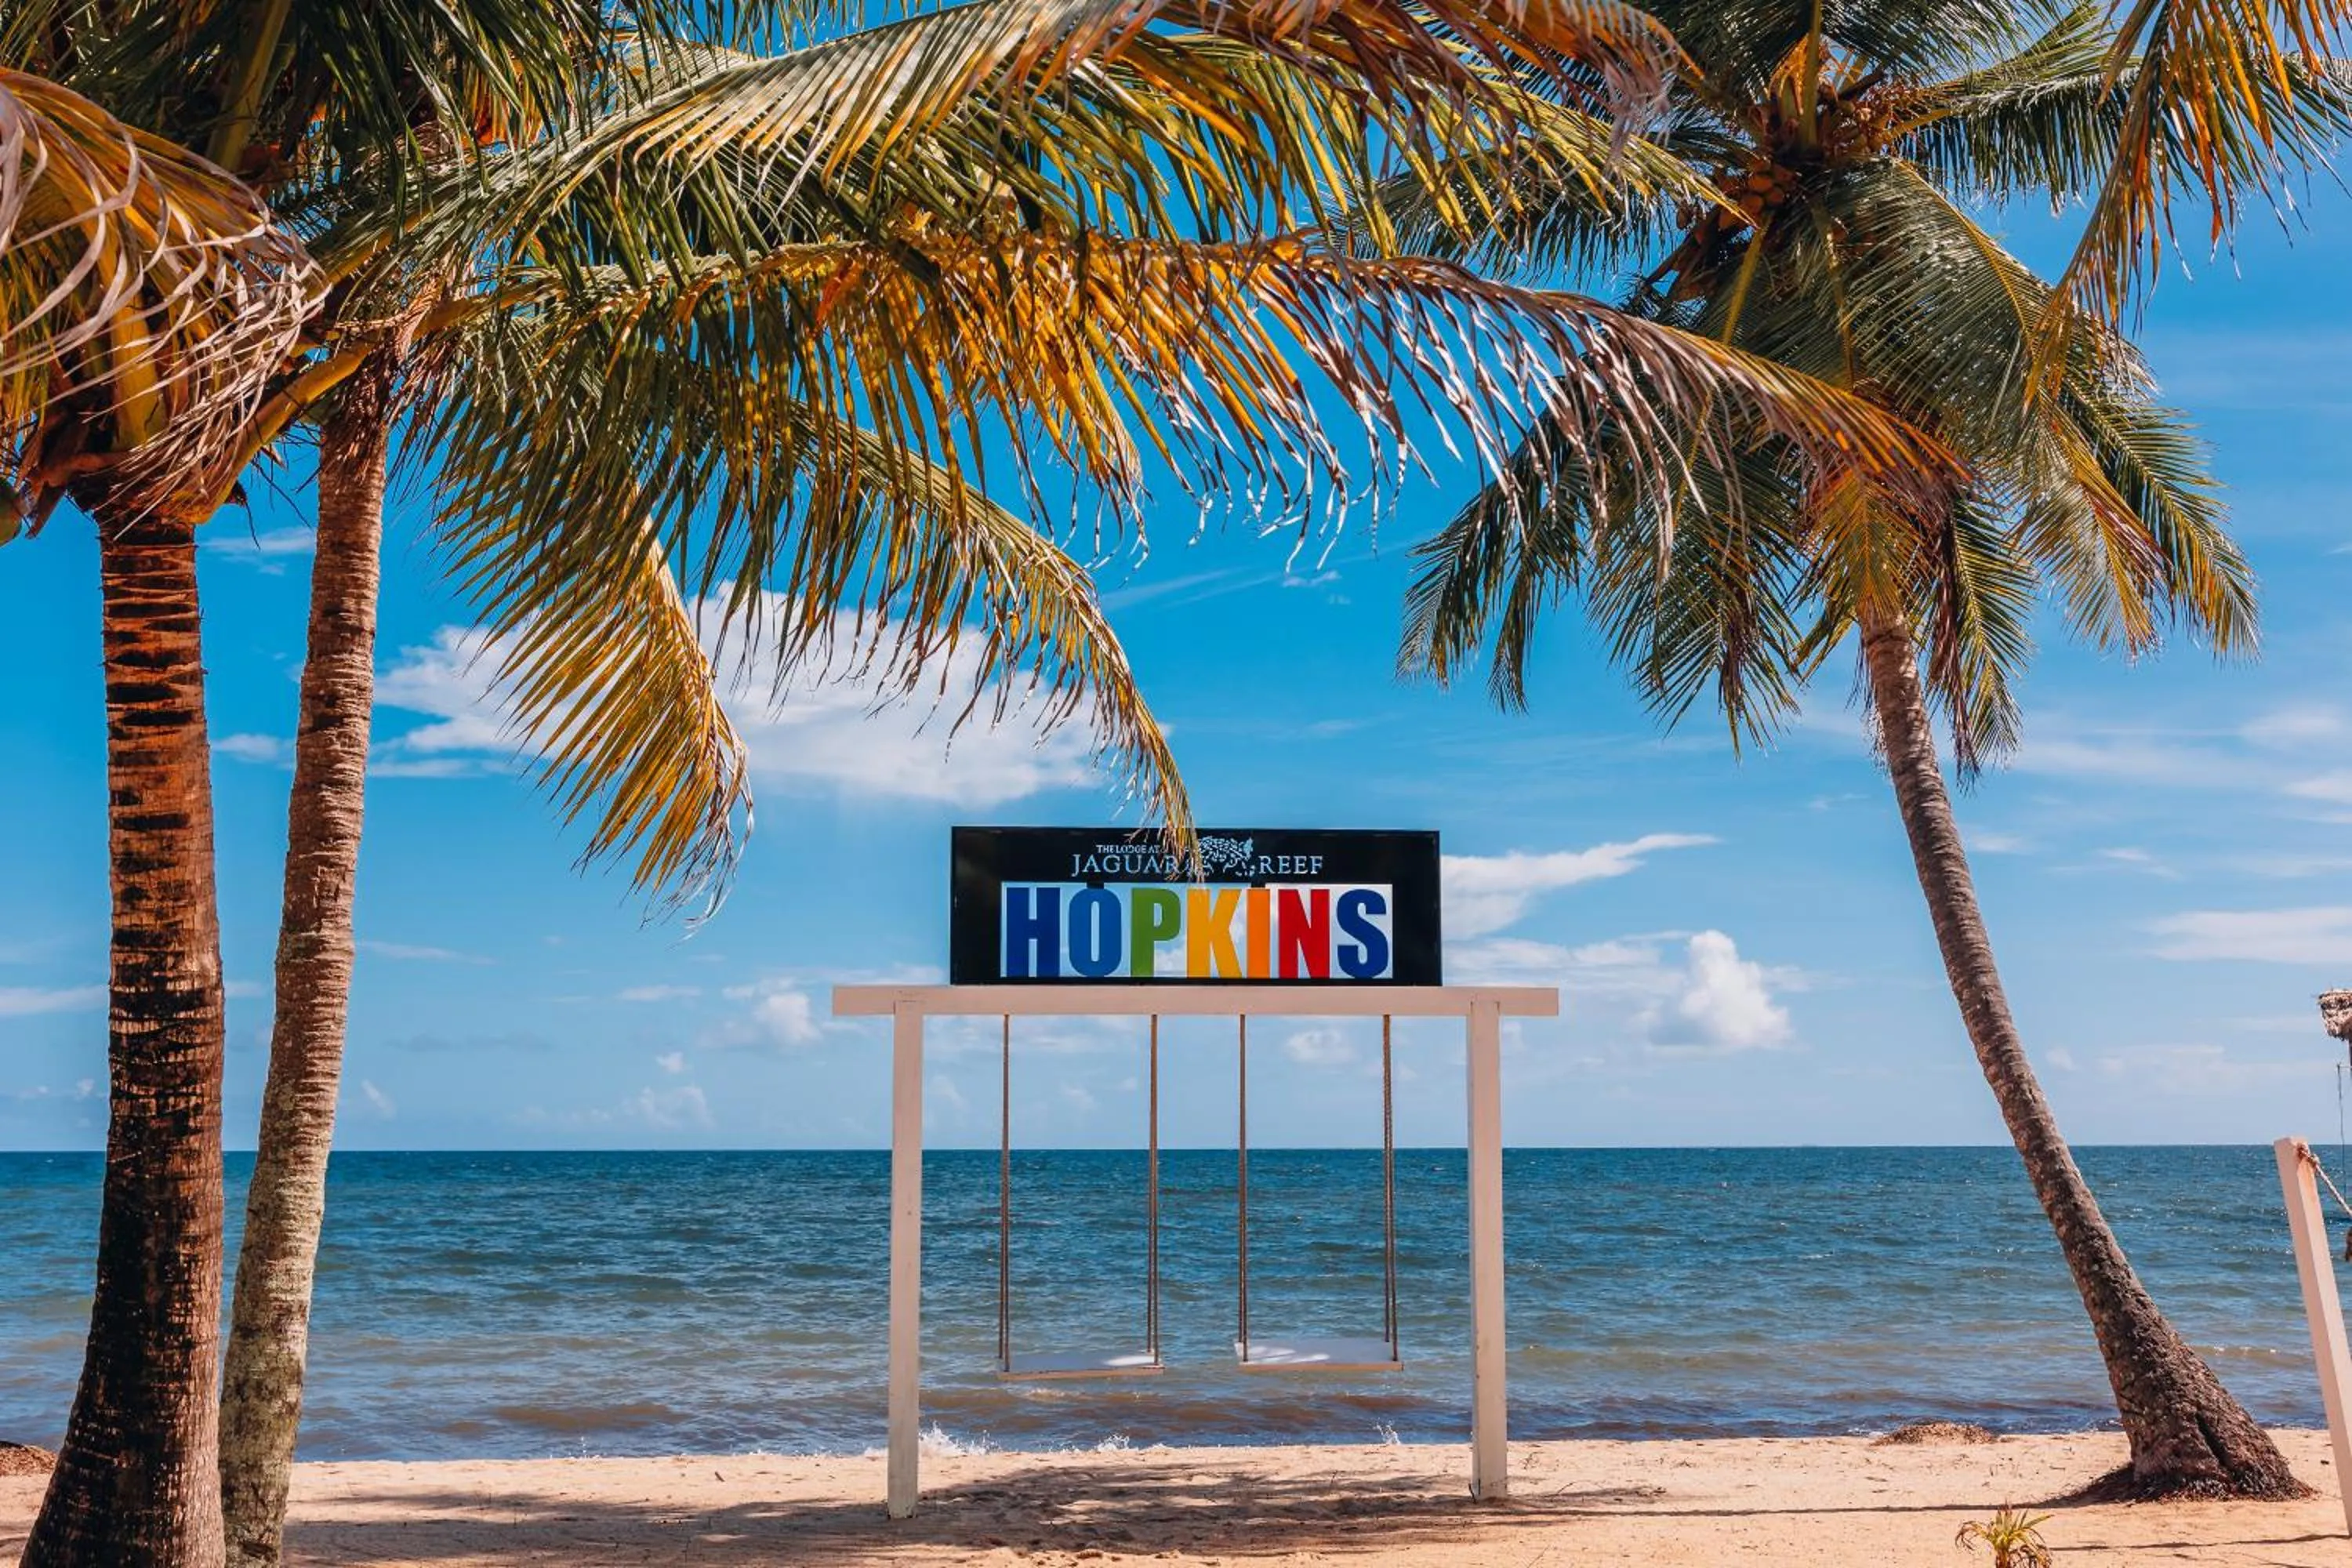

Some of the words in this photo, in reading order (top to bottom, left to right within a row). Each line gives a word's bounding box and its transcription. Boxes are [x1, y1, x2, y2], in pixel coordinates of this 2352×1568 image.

[1096, 844, 1114, 854] THE
[1116, 844, 1147, 854] LODGE
[1147, 844, 1160, 854] AT
[1071, 854, 1185, 877] JAGUAR
[1258, 855, 1323, 874] REEF
[1006, 887, 1388, 979] HOPKINS
